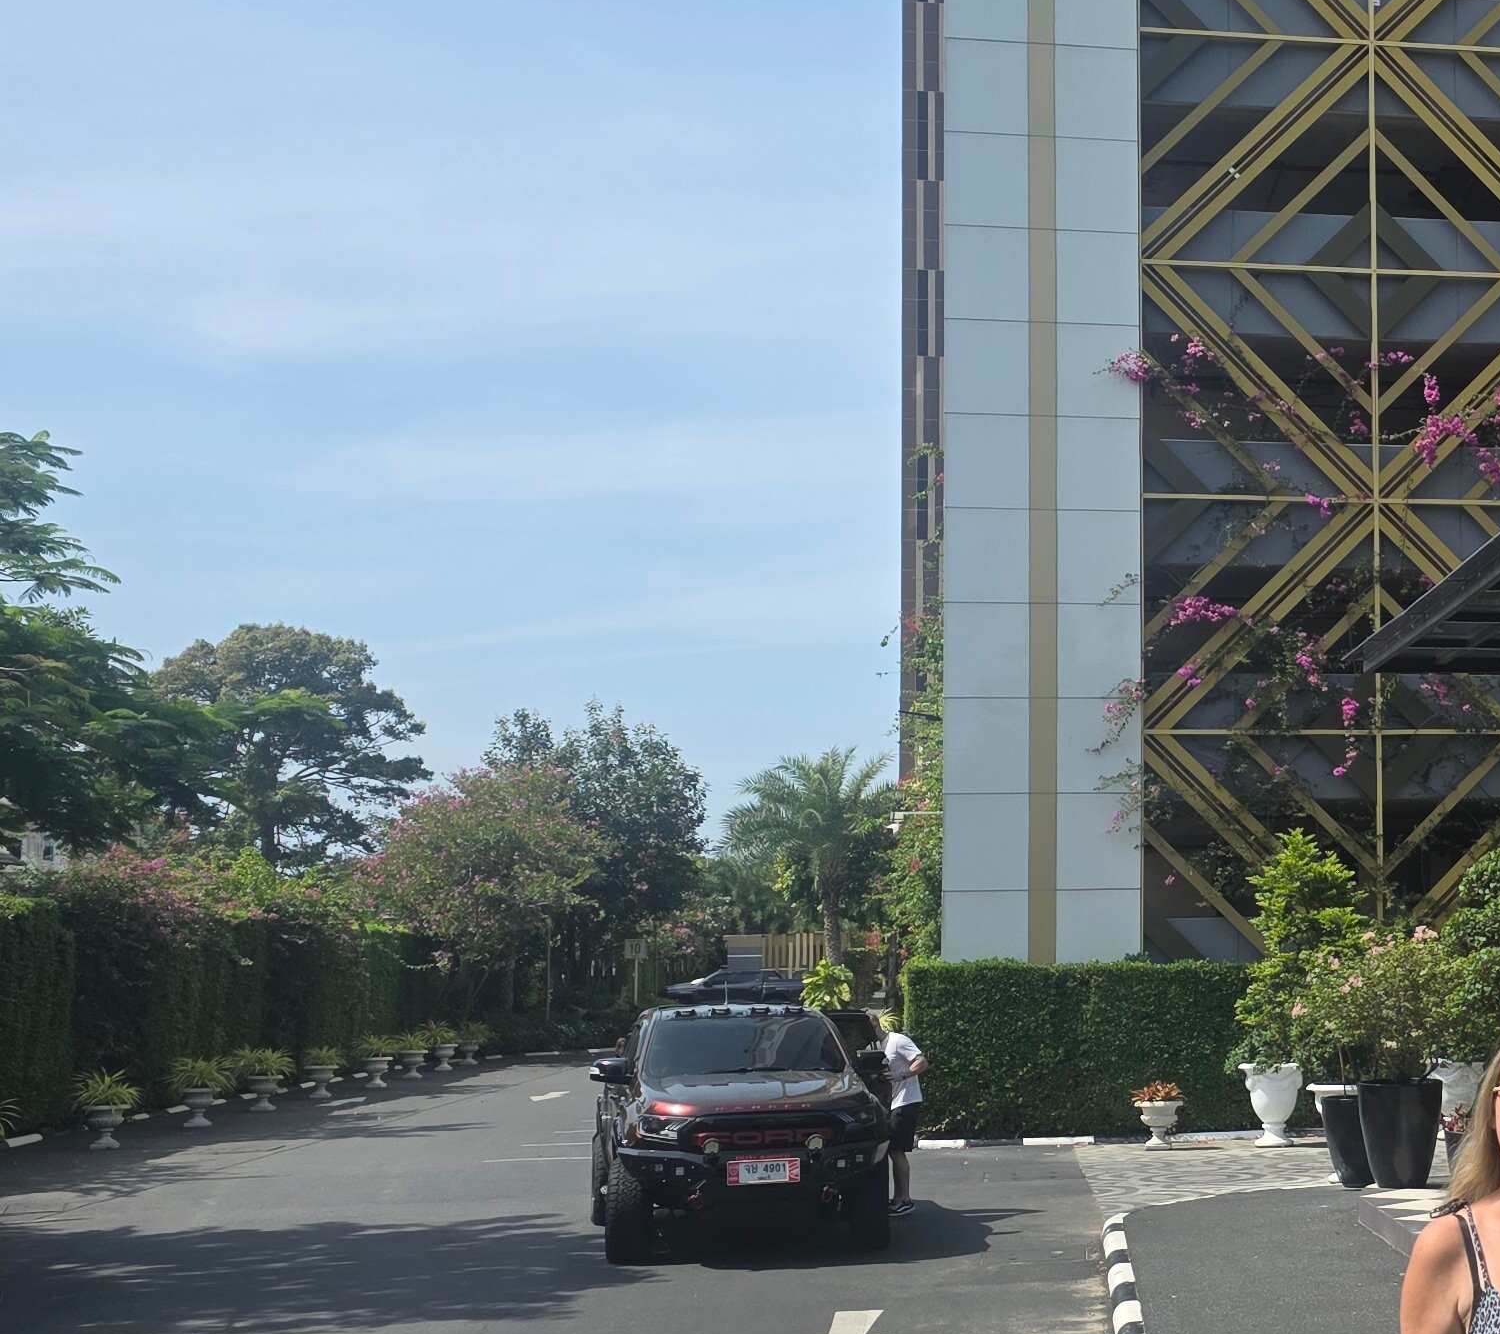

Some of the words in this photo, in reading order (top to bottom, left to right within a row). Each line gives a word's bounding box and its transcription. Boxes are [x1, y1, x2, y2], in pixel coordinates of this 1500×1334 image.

[630, 942, 641, 955] 10
[693, 1127, 833, 1146] FORD
[763, 1162, 786, 1173] 4901
